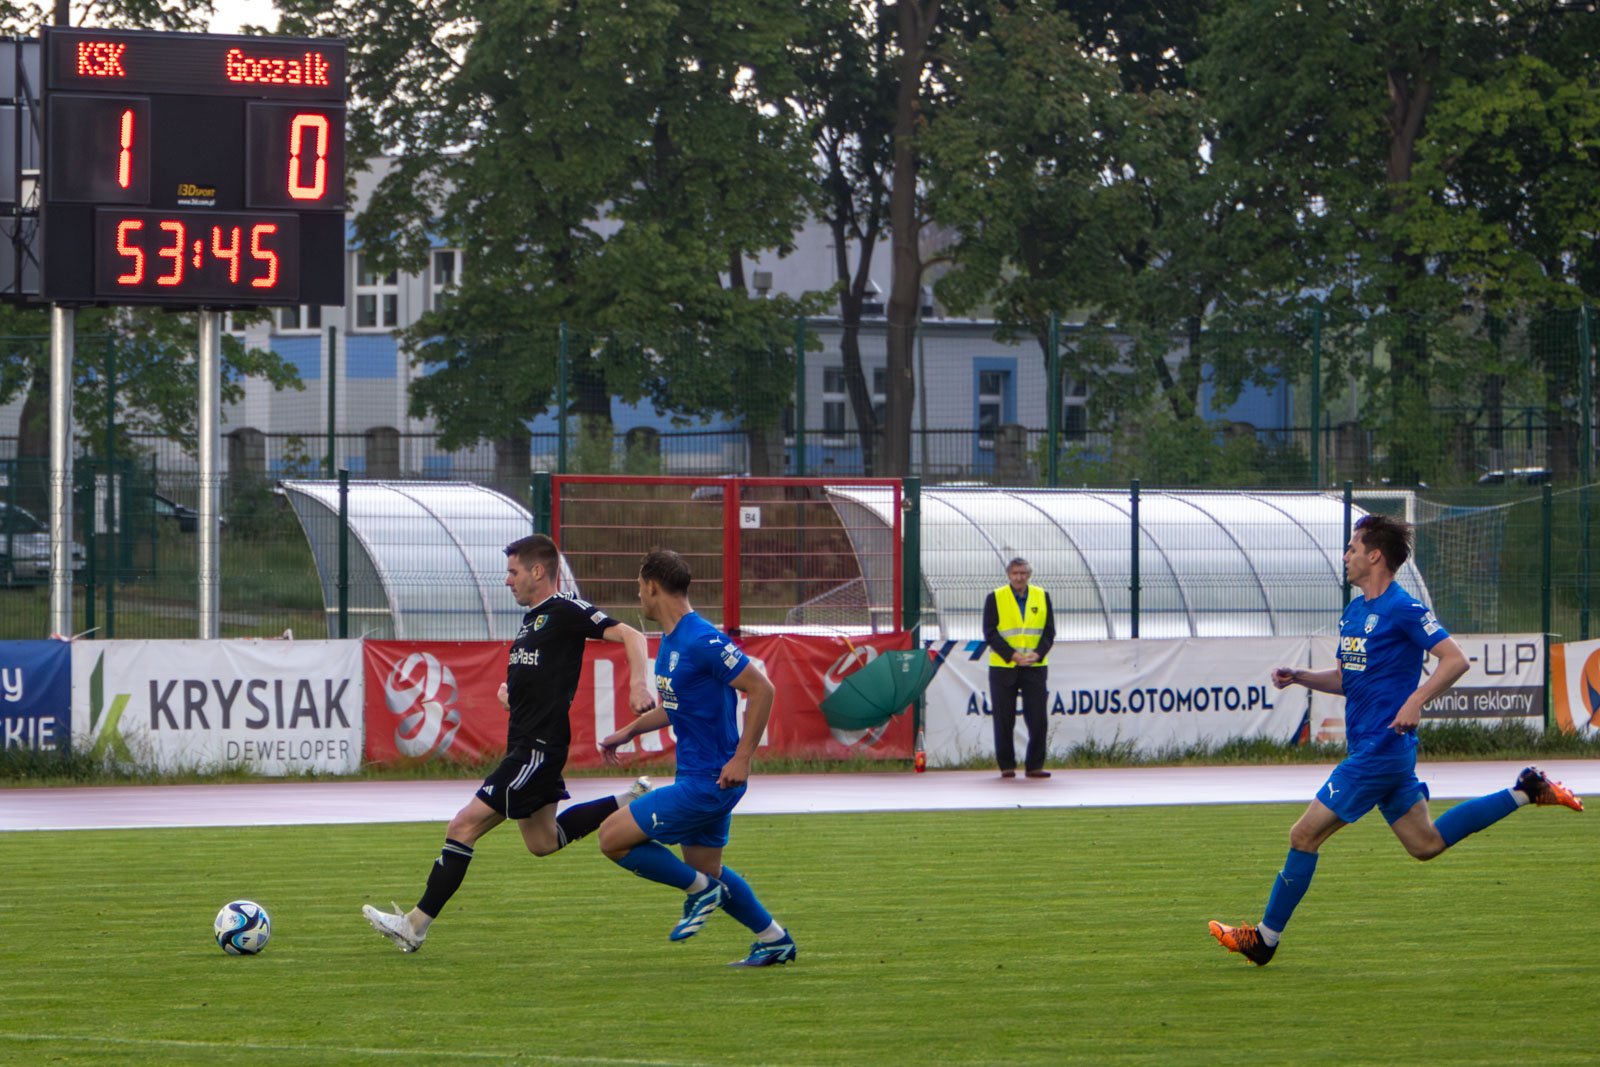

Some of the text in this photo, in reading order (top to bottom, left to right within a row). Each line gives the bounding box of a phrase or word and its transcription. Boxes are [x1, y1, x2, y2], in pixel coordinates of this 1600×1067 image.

[77, 42, 126, 77] KSK
[225, 49, 330, 86] Goczalk
[118, 109, 134, 189] 1
[287, 114, 329, 200] 0
[115, 219, 279, 288] 53:45
[745, 513, 756, 523] B4
[149, 678, 351, 730] KRYSIAK
[1474, 690, 1533, 713] reklamy
[0, 717, 56, 752] KIE
[227, 739, 350, 761] DEWELOPER
